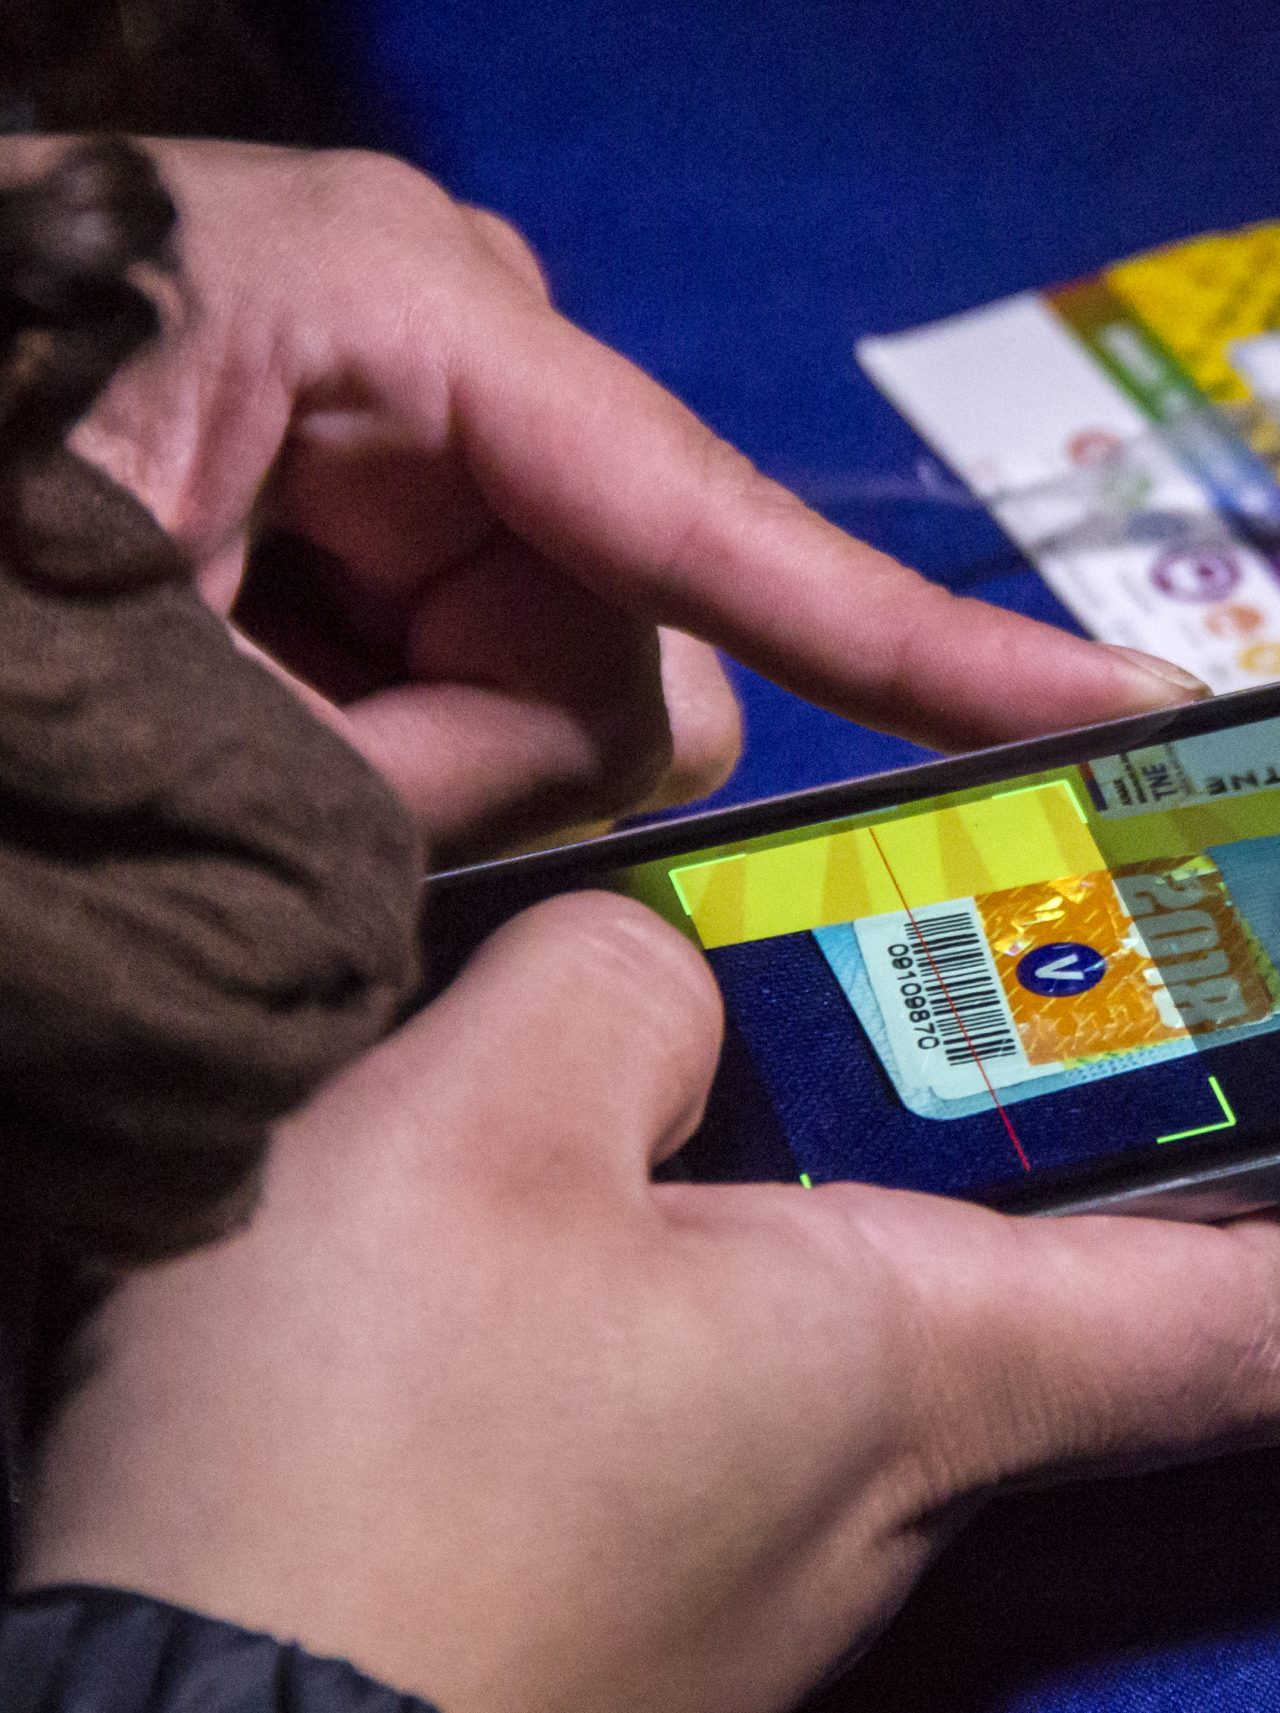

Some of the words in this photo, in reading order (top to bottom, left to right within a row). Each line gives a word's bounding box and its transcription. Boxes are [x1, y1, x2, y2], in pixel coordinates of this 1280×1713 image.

[1141, 761, 1177, 801] TNE
[1034, 953, 1086, 981] V
[1110, 867, 1248, 1030] 2018
[886, 942, 941, 1051] 09109870
